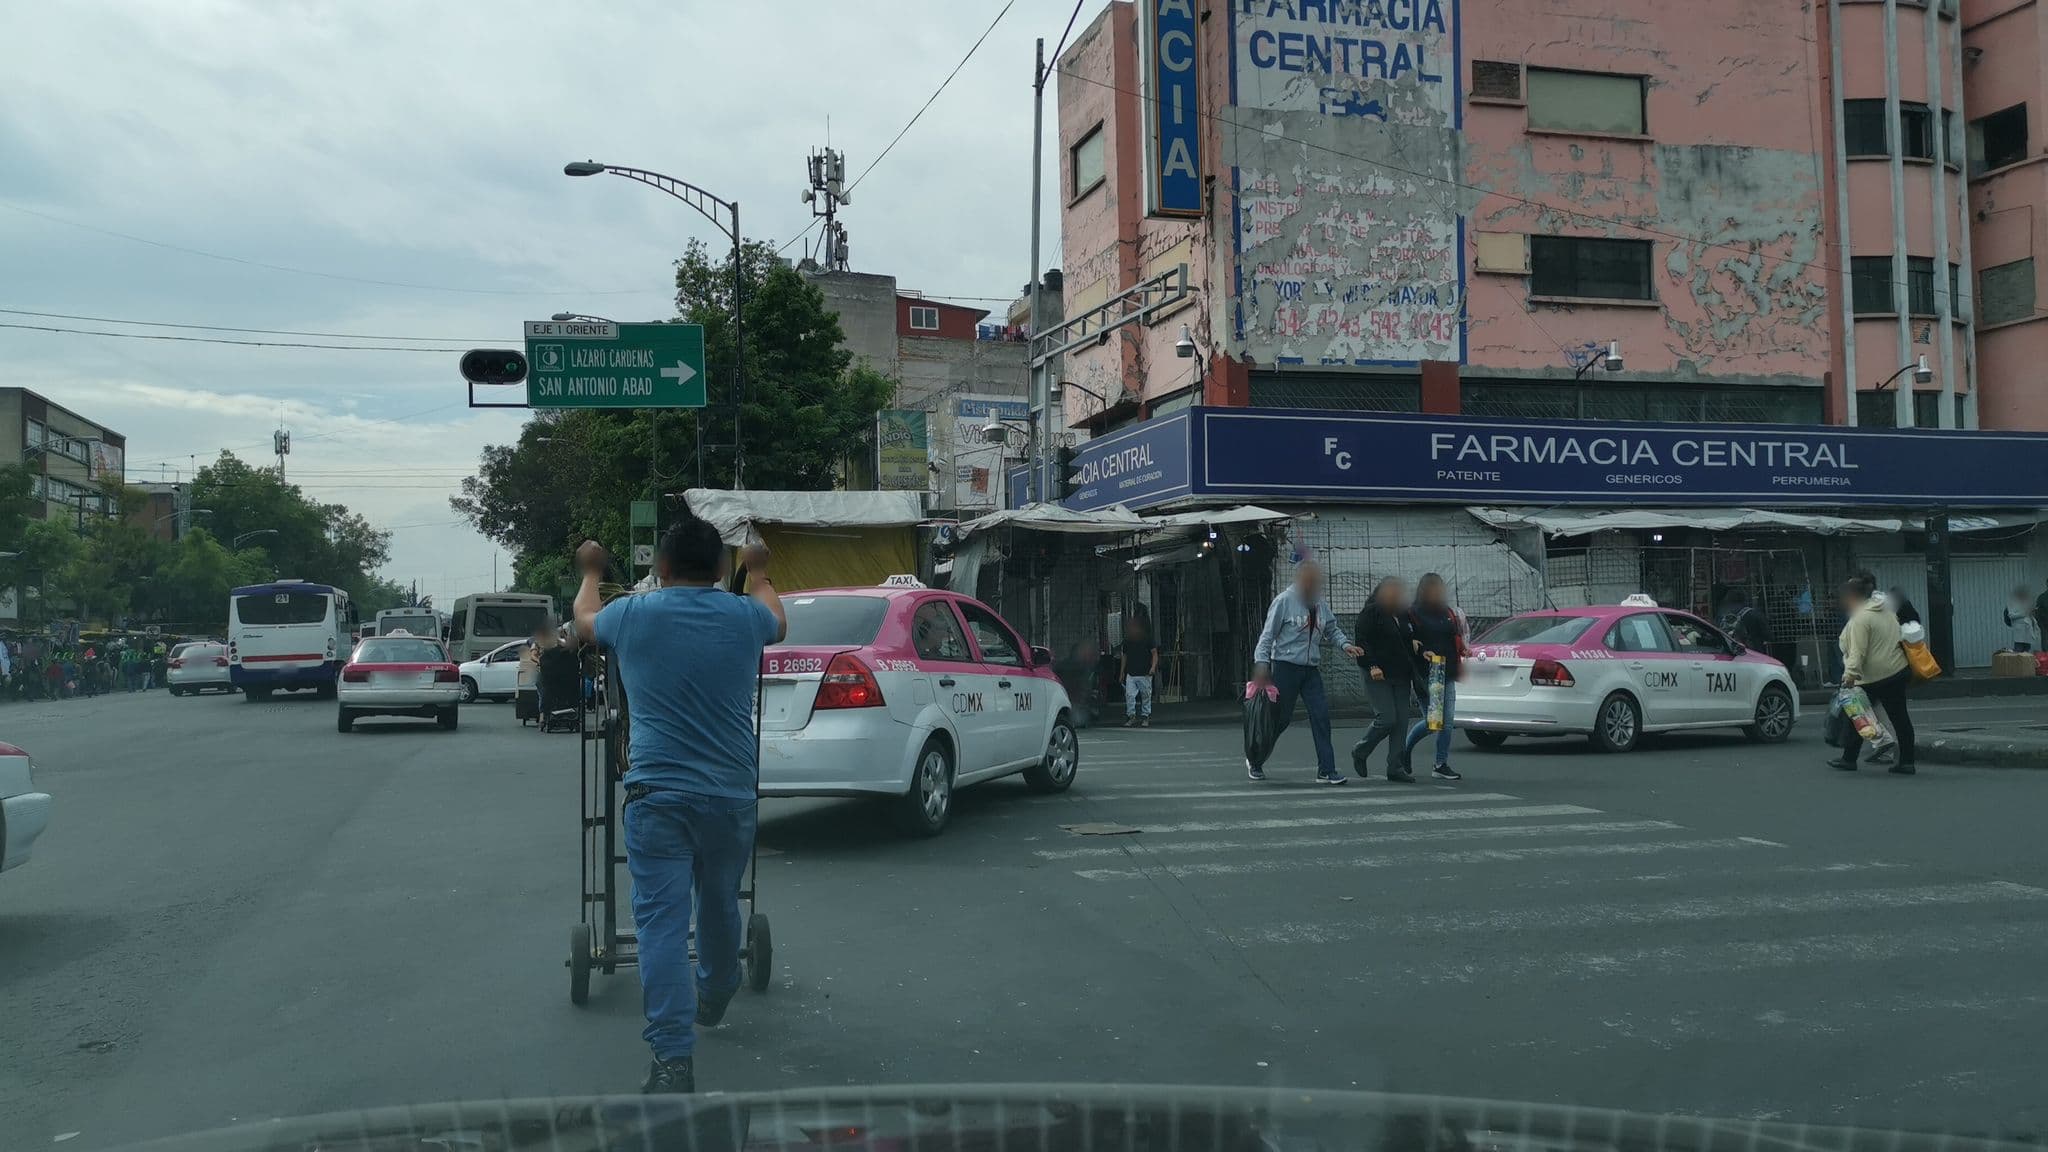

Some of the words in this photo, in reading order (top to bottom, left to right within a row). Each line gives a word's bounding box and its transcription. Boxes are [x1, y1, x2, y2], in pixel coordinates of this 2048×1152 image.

[1250, 29, 1443, 83] CENTRAL
[533, 324, 553, 334] EJE
[566, 325, 609, 335] ORIENTE
[570, 348, 606, 368] LAZARO
[609, 349, 654, 369] CARDENAS
[539, 377, 562, 397] SAN
[567, 377, 617, 397] ANTONIO
[622, 377, 652, 397] ABAD
[880, 431, 912, 446] INDIO
[1431, 432, 1660, 466] FARMACIA
[1671, 440, 1859, 469] CENTRAL
[1101, 443, 1154, 479] CENTRAL
[1437, 470, 1501, 482] PATENTE
[1605, 474, 1683, 485] GENERICOS
[1772, 475, 1851, 486] PERFUMERIA
[890, 575, 913, 586] TAXI
[769, 659, 780, 673] B
[783, 658, 822, 673] 26952
[875, 659, 889, 672] B
[1644, 671, 1679, 688] CDMX
[1705, 672, 1737, 693] TAXI
[952, 692, 984, 714] CDMX
[1014, 692, 1032, 712] TAXI
